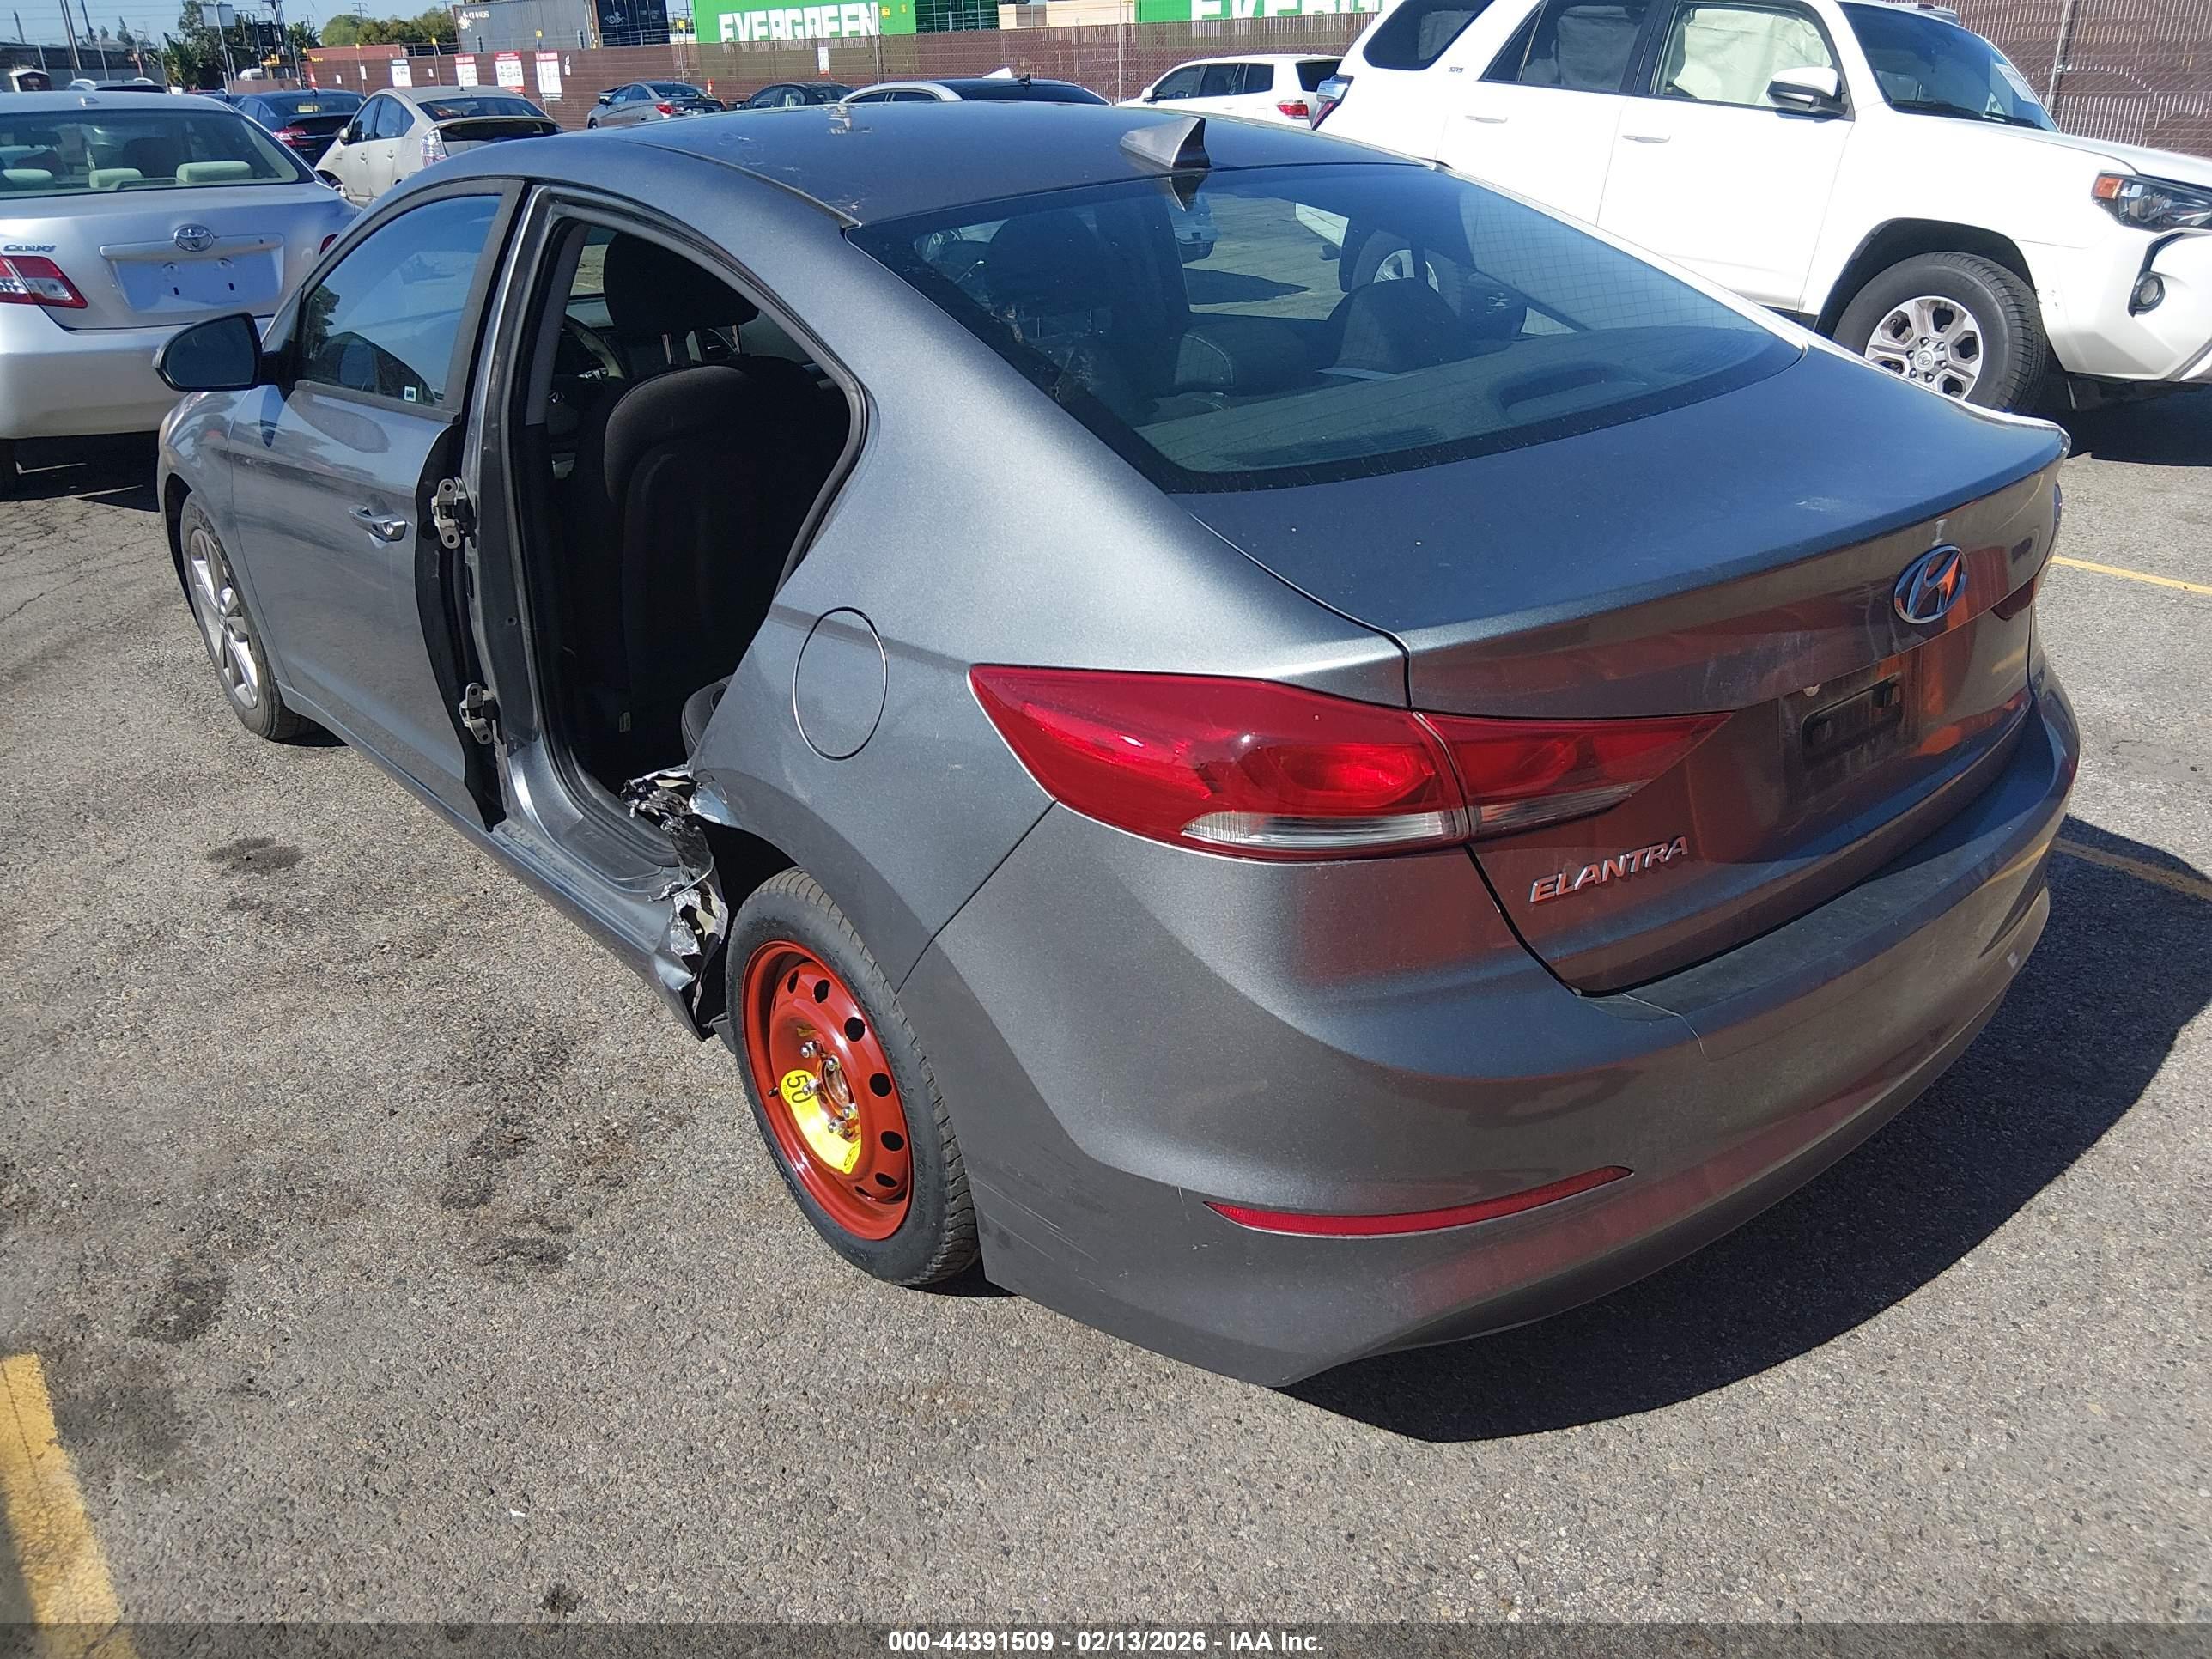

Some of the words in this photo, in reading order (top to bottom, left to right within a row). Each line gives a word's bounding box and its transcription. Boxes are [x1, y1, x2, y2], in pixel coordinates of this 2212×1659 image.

[718, 2, 880, 43] EVERGREEN
[1529, 835, 1689, 903] ELANTRA
[787, 1077, 813, 1103] 50
